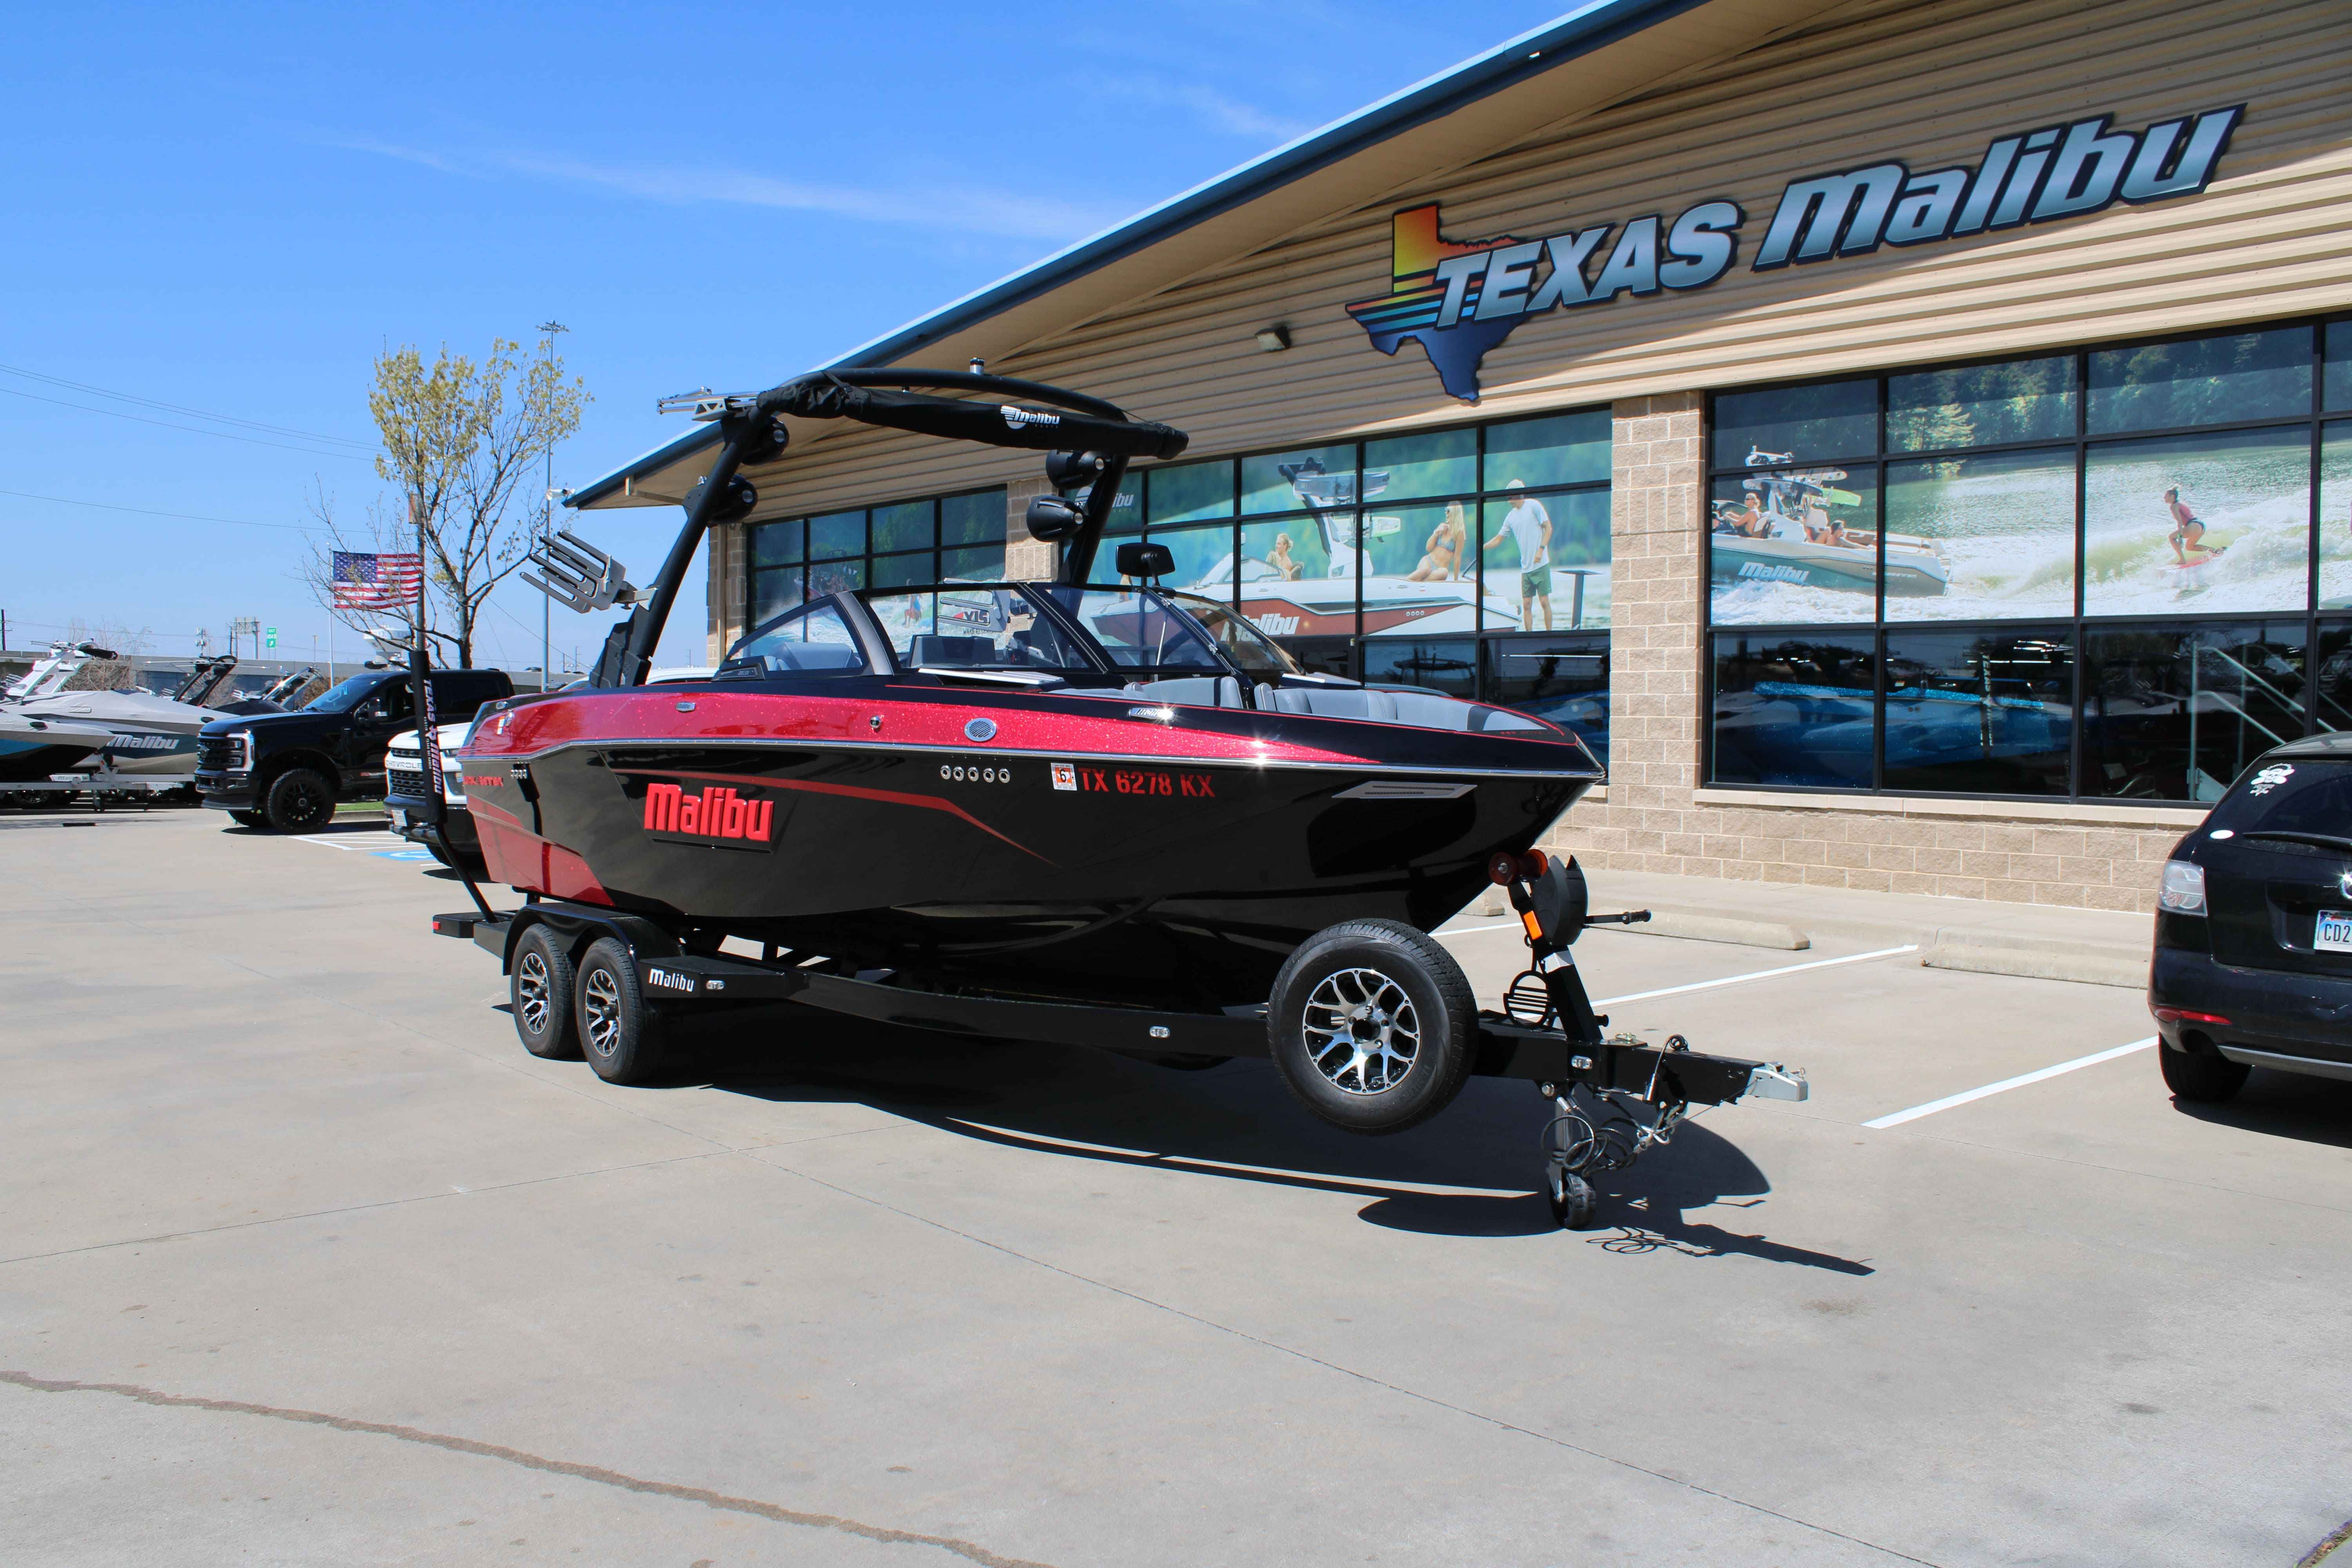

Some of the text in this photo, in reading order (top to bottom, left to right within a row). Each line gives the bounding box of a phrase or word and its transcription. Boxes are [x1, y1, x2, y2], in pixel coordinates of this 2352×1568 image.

[1435, 104, 2244, 328] TEXAS Malibu
[1014, 411, 1060, 424] Malibu
[1112, 493, 1134, 508] ibu
[1737, 562, 1809, 583] Malibu
[423, 679, 436, 722] TEXAS
[106, 734, 180, 749] Malibu
[386, 760, 423, 769] CHEVROLE
[430, 742, 442, 795] Malibu
[1060, 768, 1066, 783] 6
[1078, 767, 1216, 797] TX 6278 KX
[644, 783, 774, 842] Malibu
[2324, 924, 2350, 942] CD2
[649, 968, 694, 992] Malibu
